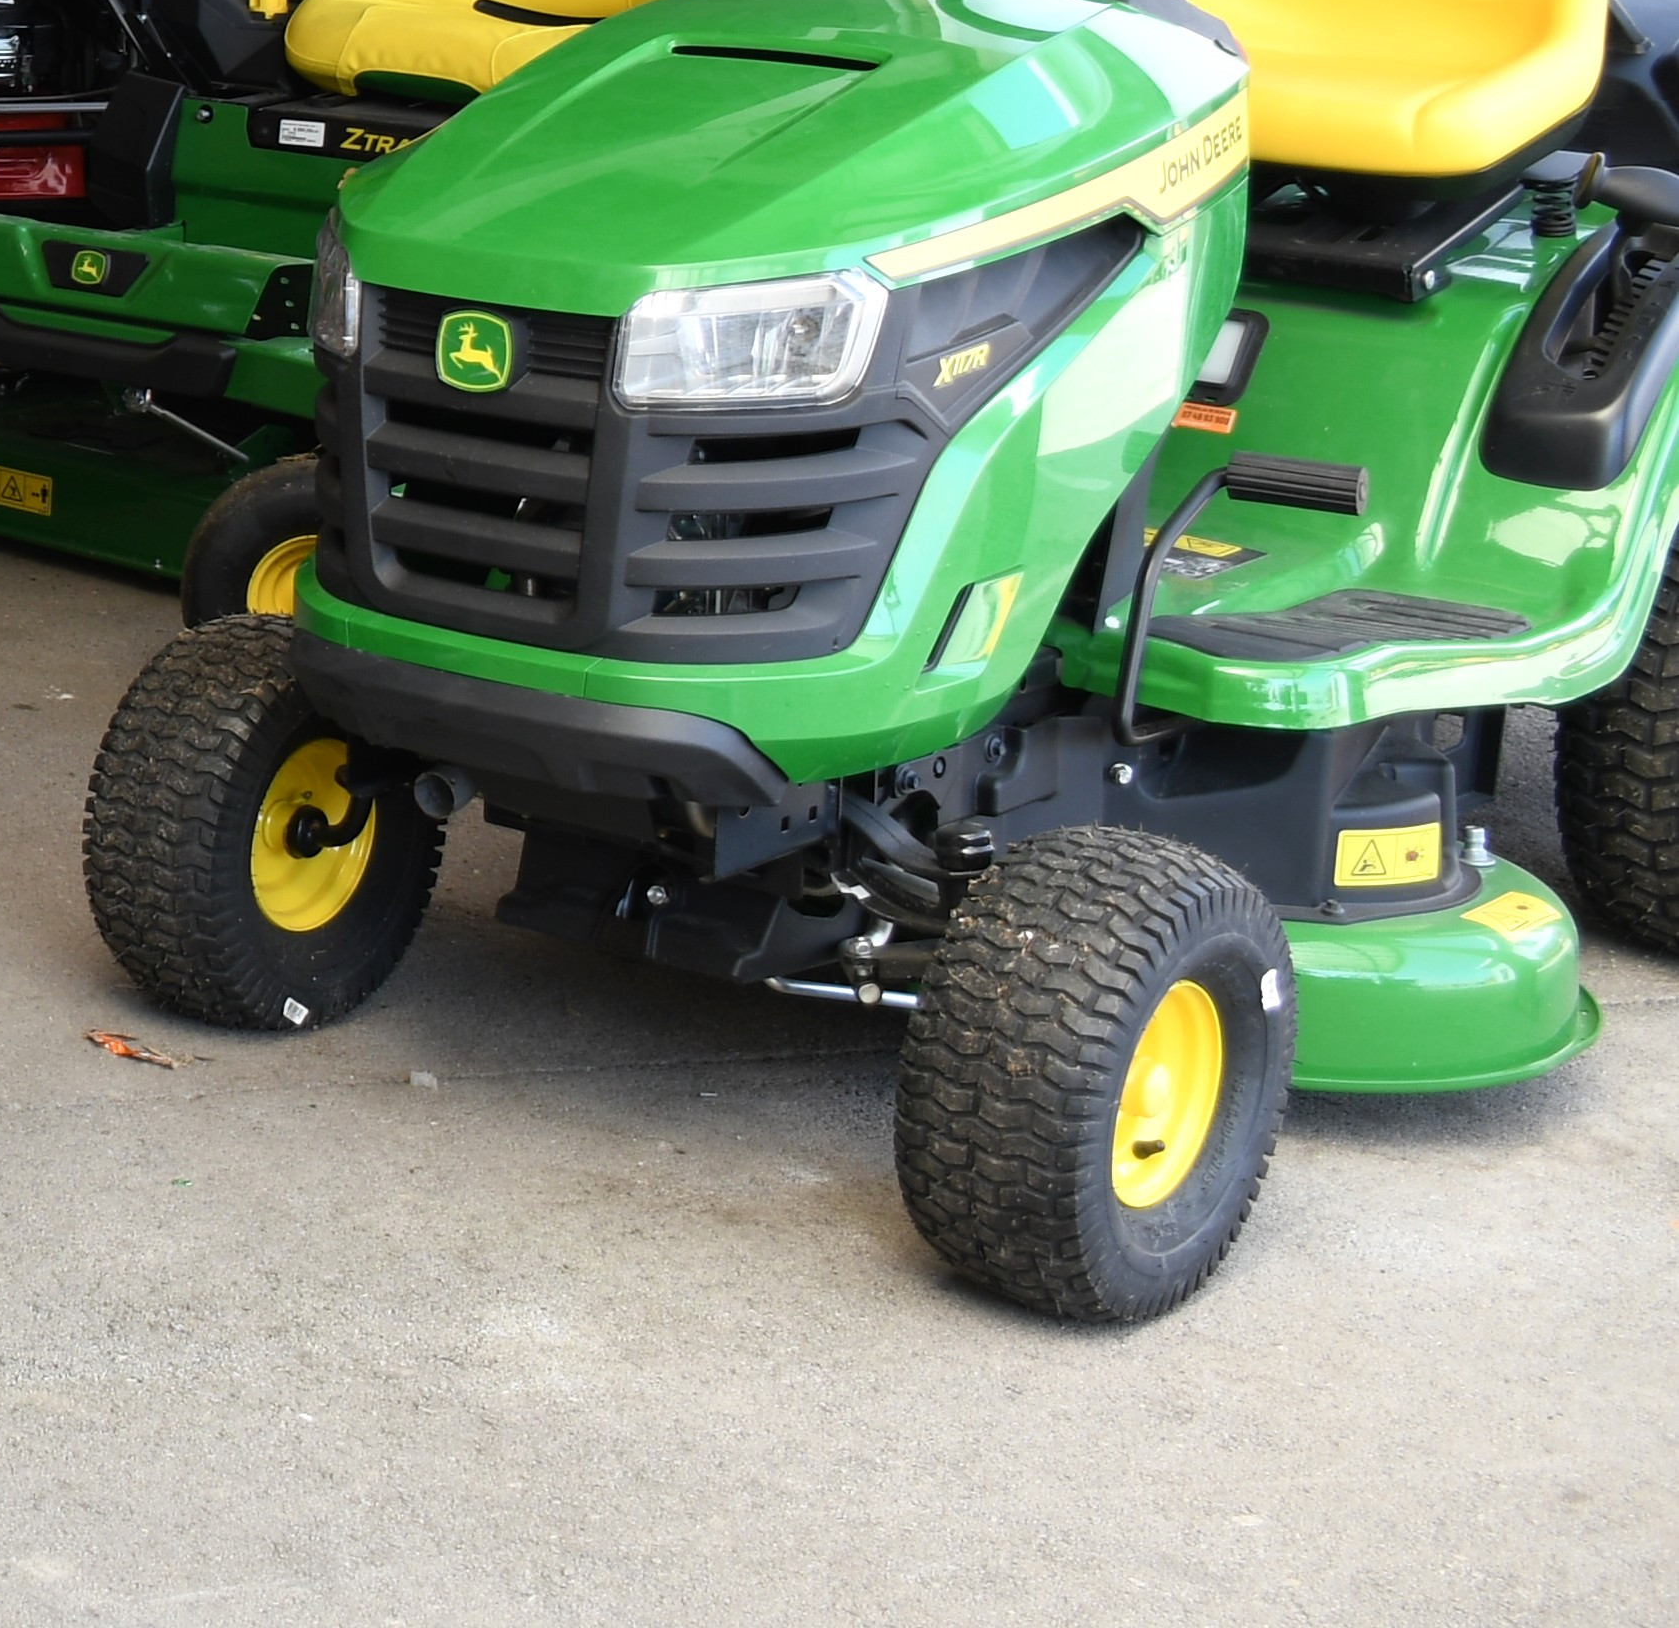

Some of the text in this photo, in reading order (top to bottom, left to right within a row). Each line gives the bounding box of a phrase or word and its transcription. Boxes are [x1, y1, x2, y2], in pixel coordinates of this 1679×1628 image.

[1159, 115, 1243, 195] JOHN DEERE
[932, 341, 990, 389] X117R
